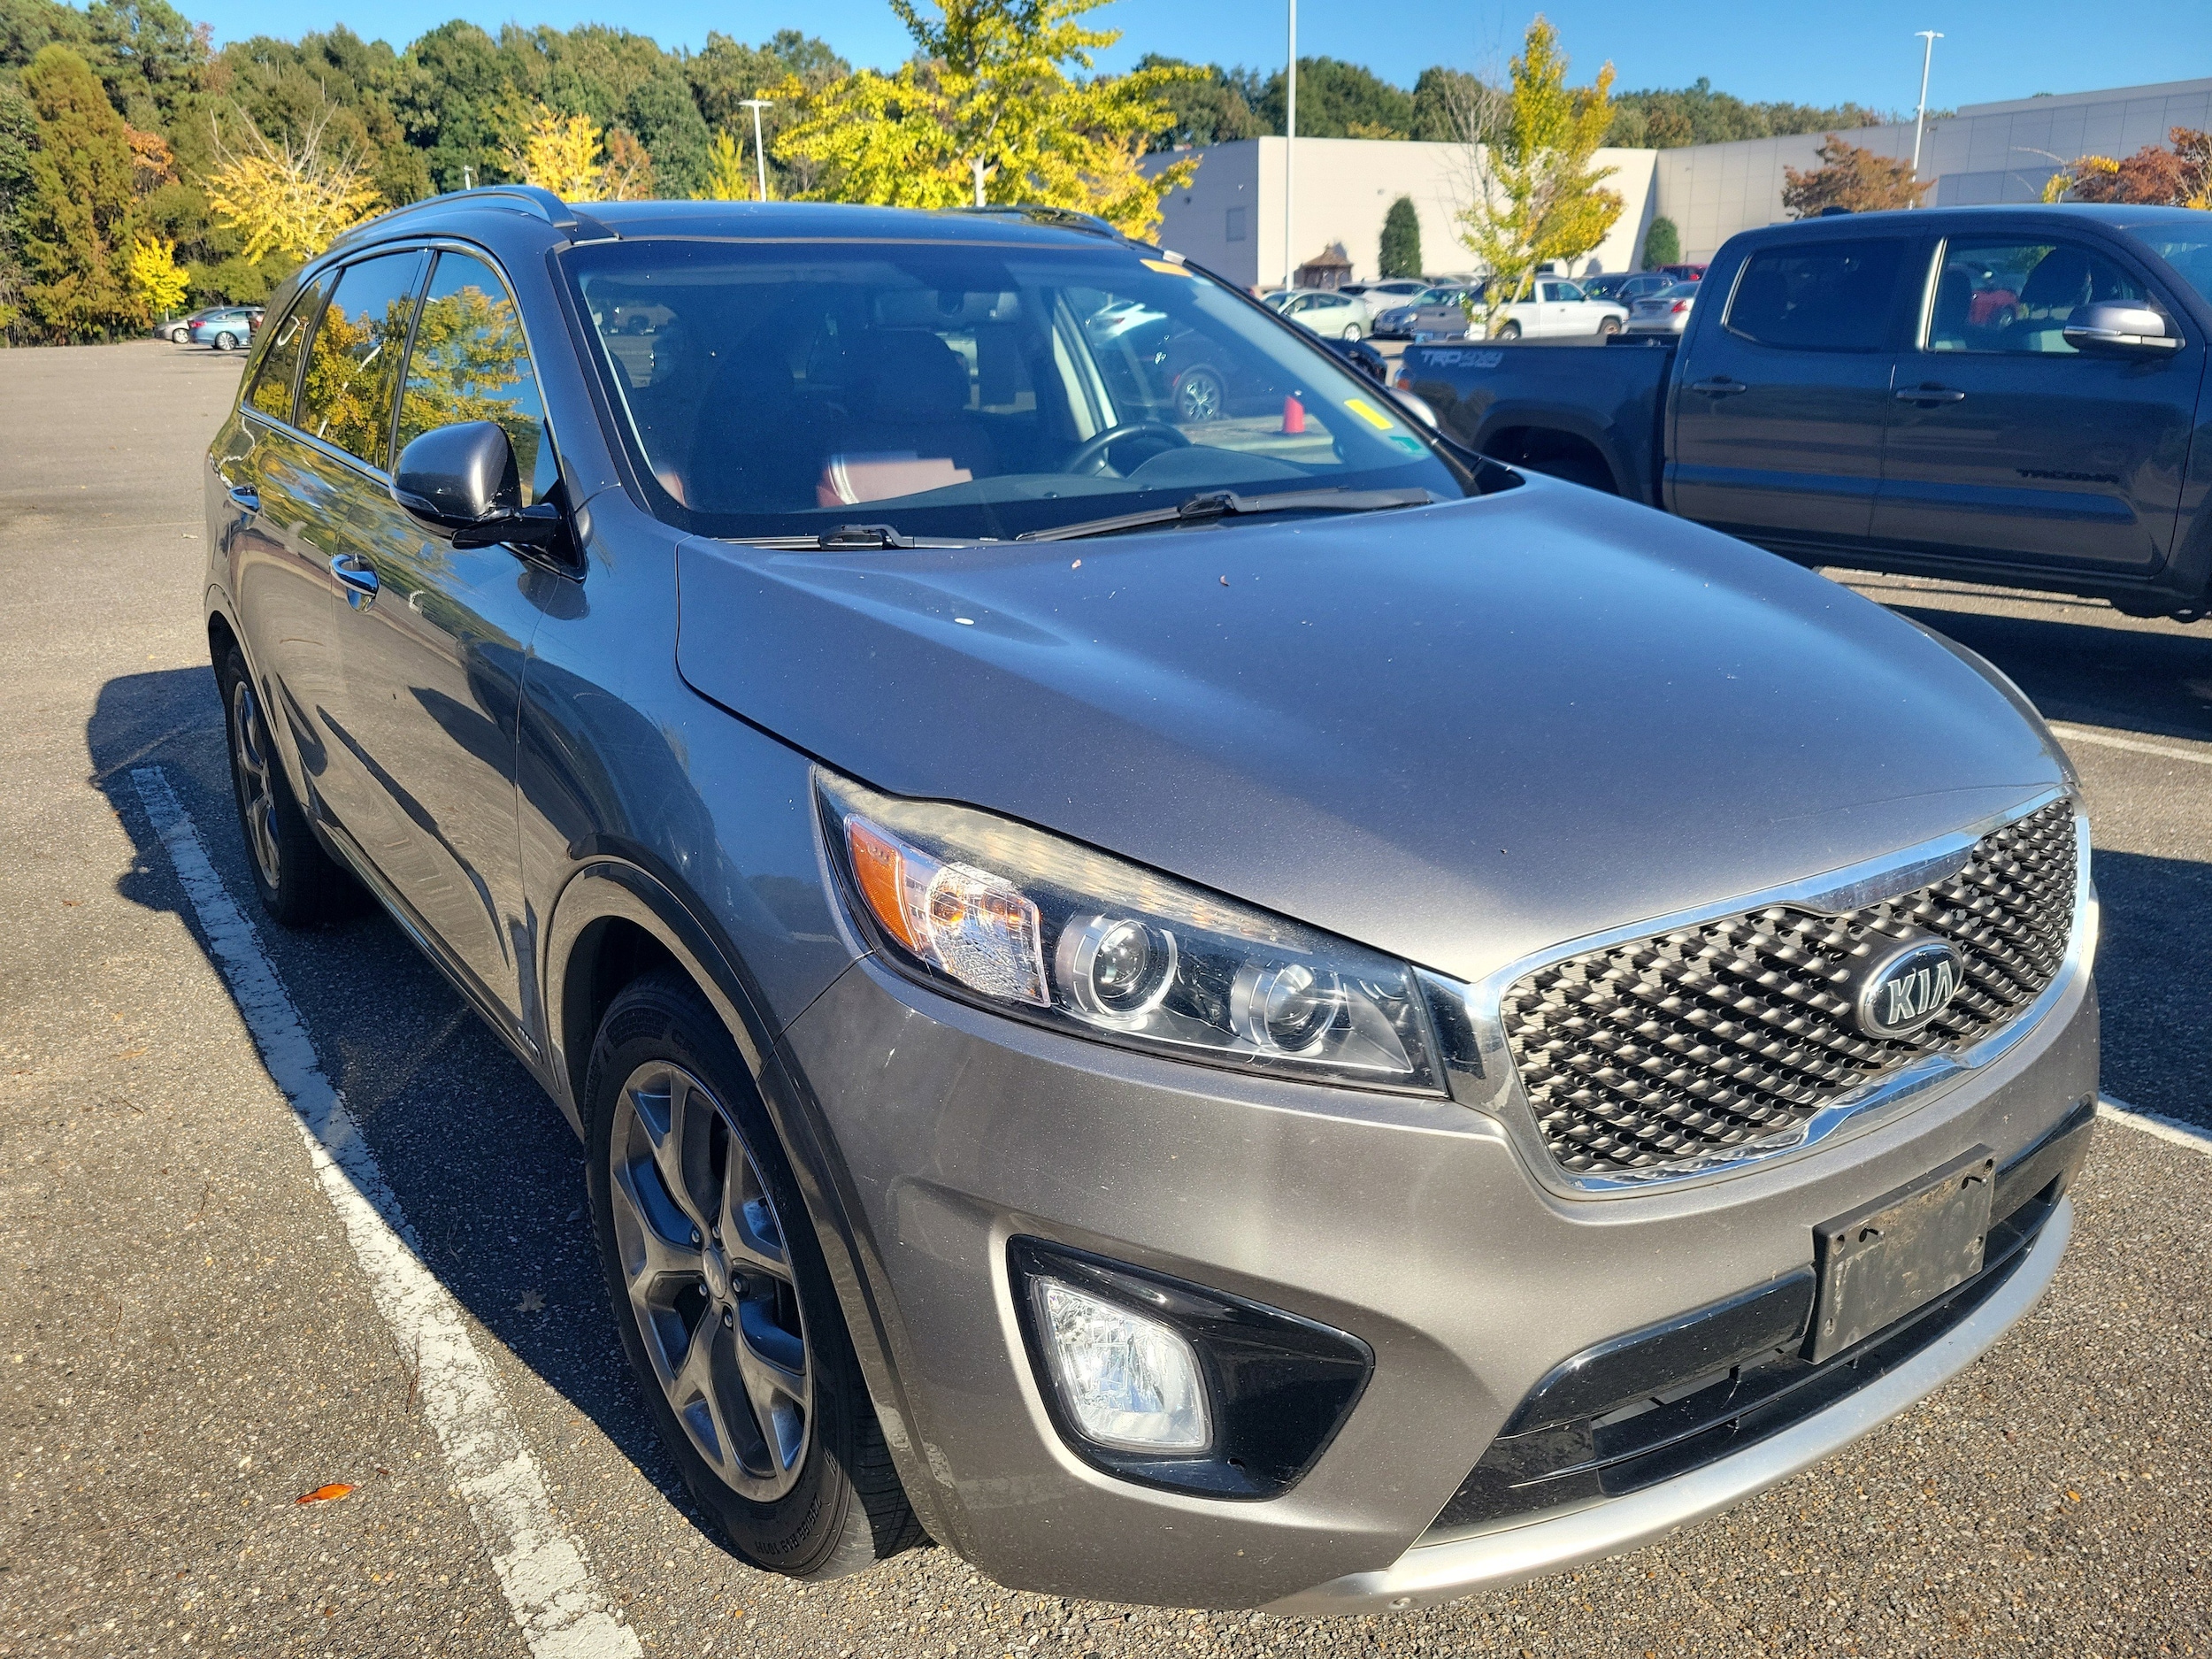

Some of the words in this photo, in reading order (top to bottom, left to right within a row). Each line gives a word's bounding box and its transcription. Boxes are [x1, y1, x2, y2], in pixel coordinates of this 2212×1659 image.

[1420, 349, 1463, 367] TRD
[1887, 960, 1955, 1025] KIA
[796, 1493, 823, 1542] 235/55
[754, 1541, 781, 1555] 101H
[780, 1533, 801, 1553] R19
